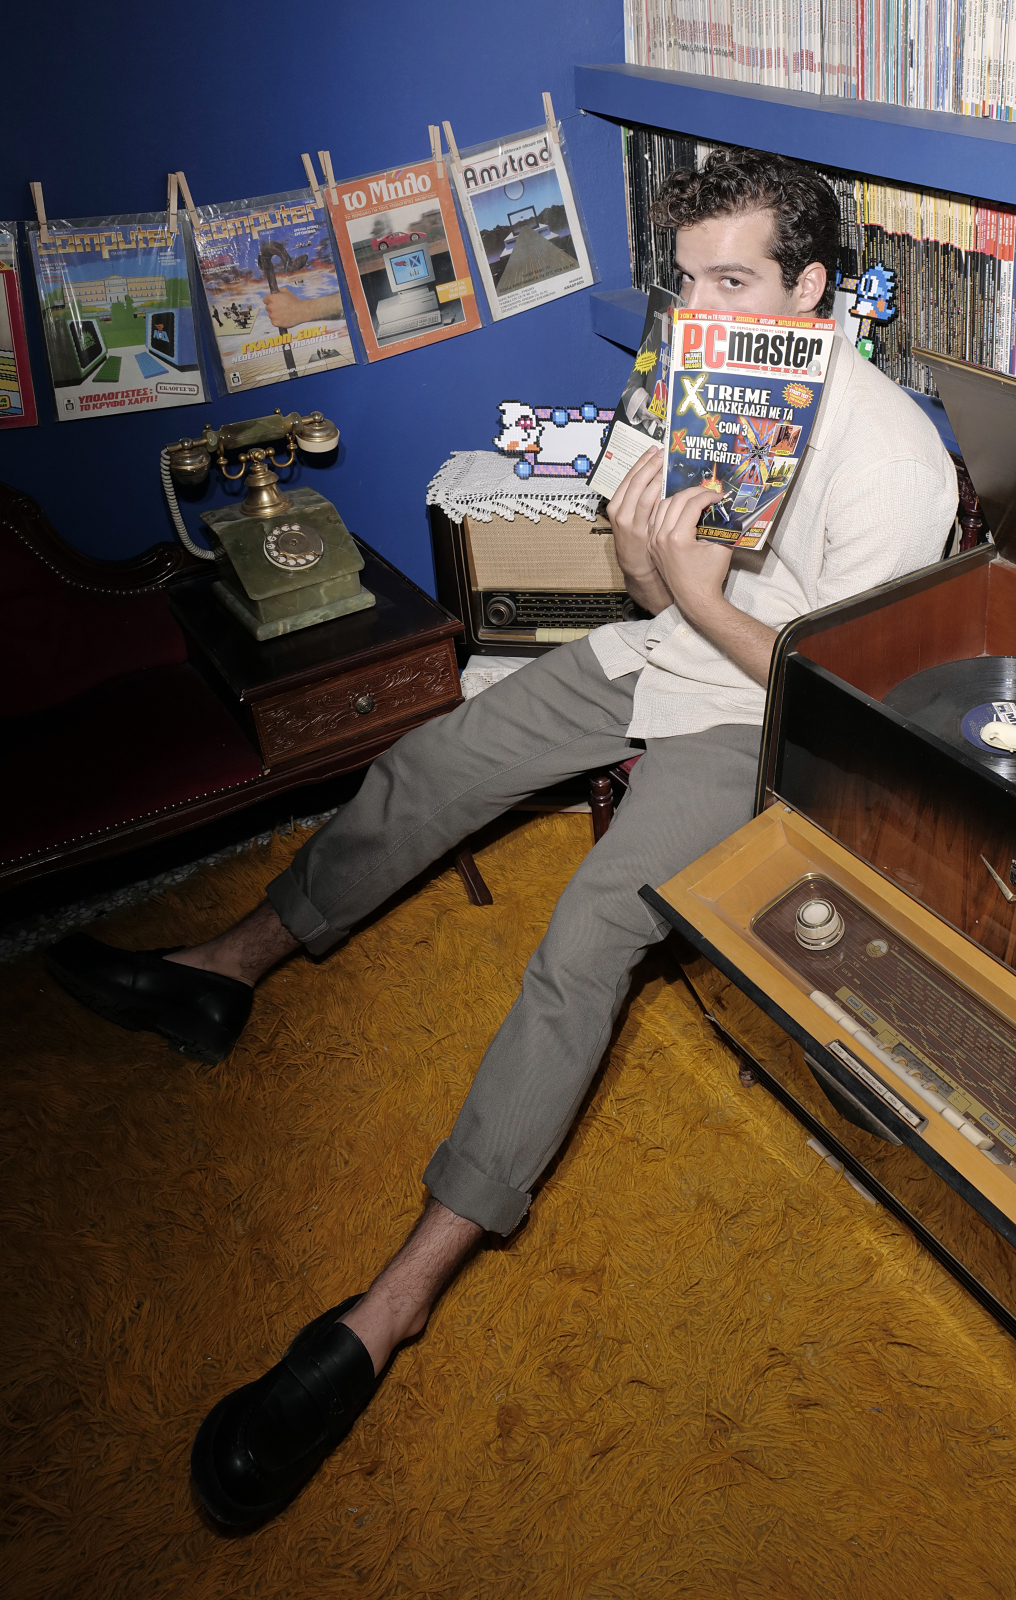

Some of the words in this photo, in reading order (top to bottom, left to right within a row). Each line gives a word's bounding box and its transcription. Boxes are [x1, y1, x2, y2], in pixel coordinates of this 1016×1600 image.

[463, 136, 551, 189] Amstrad
[342, 190, 367, 211] το
[290, 332, 340, 350] ΥΠΟΛΟΓΙΣΤΕΣ
[92, 399, 125, 410] ΚΡΥΦΟ
[706, 400, 767, 418] ΔΙΑΣΚΕΔΑΣΗ
[768, 406, 782, 419] ΜΕ
[782, 407, 794, 421] ΤΑ
[705, 415, 740, 438] X-COM
[742, 424, 748, 436] 3
[672, 430, 714, 452] X-WING
[717, 442, 728, 451] vs
[685, 447, 702, 460] TIE
[704, 449, 742, 465] FIGHTER
